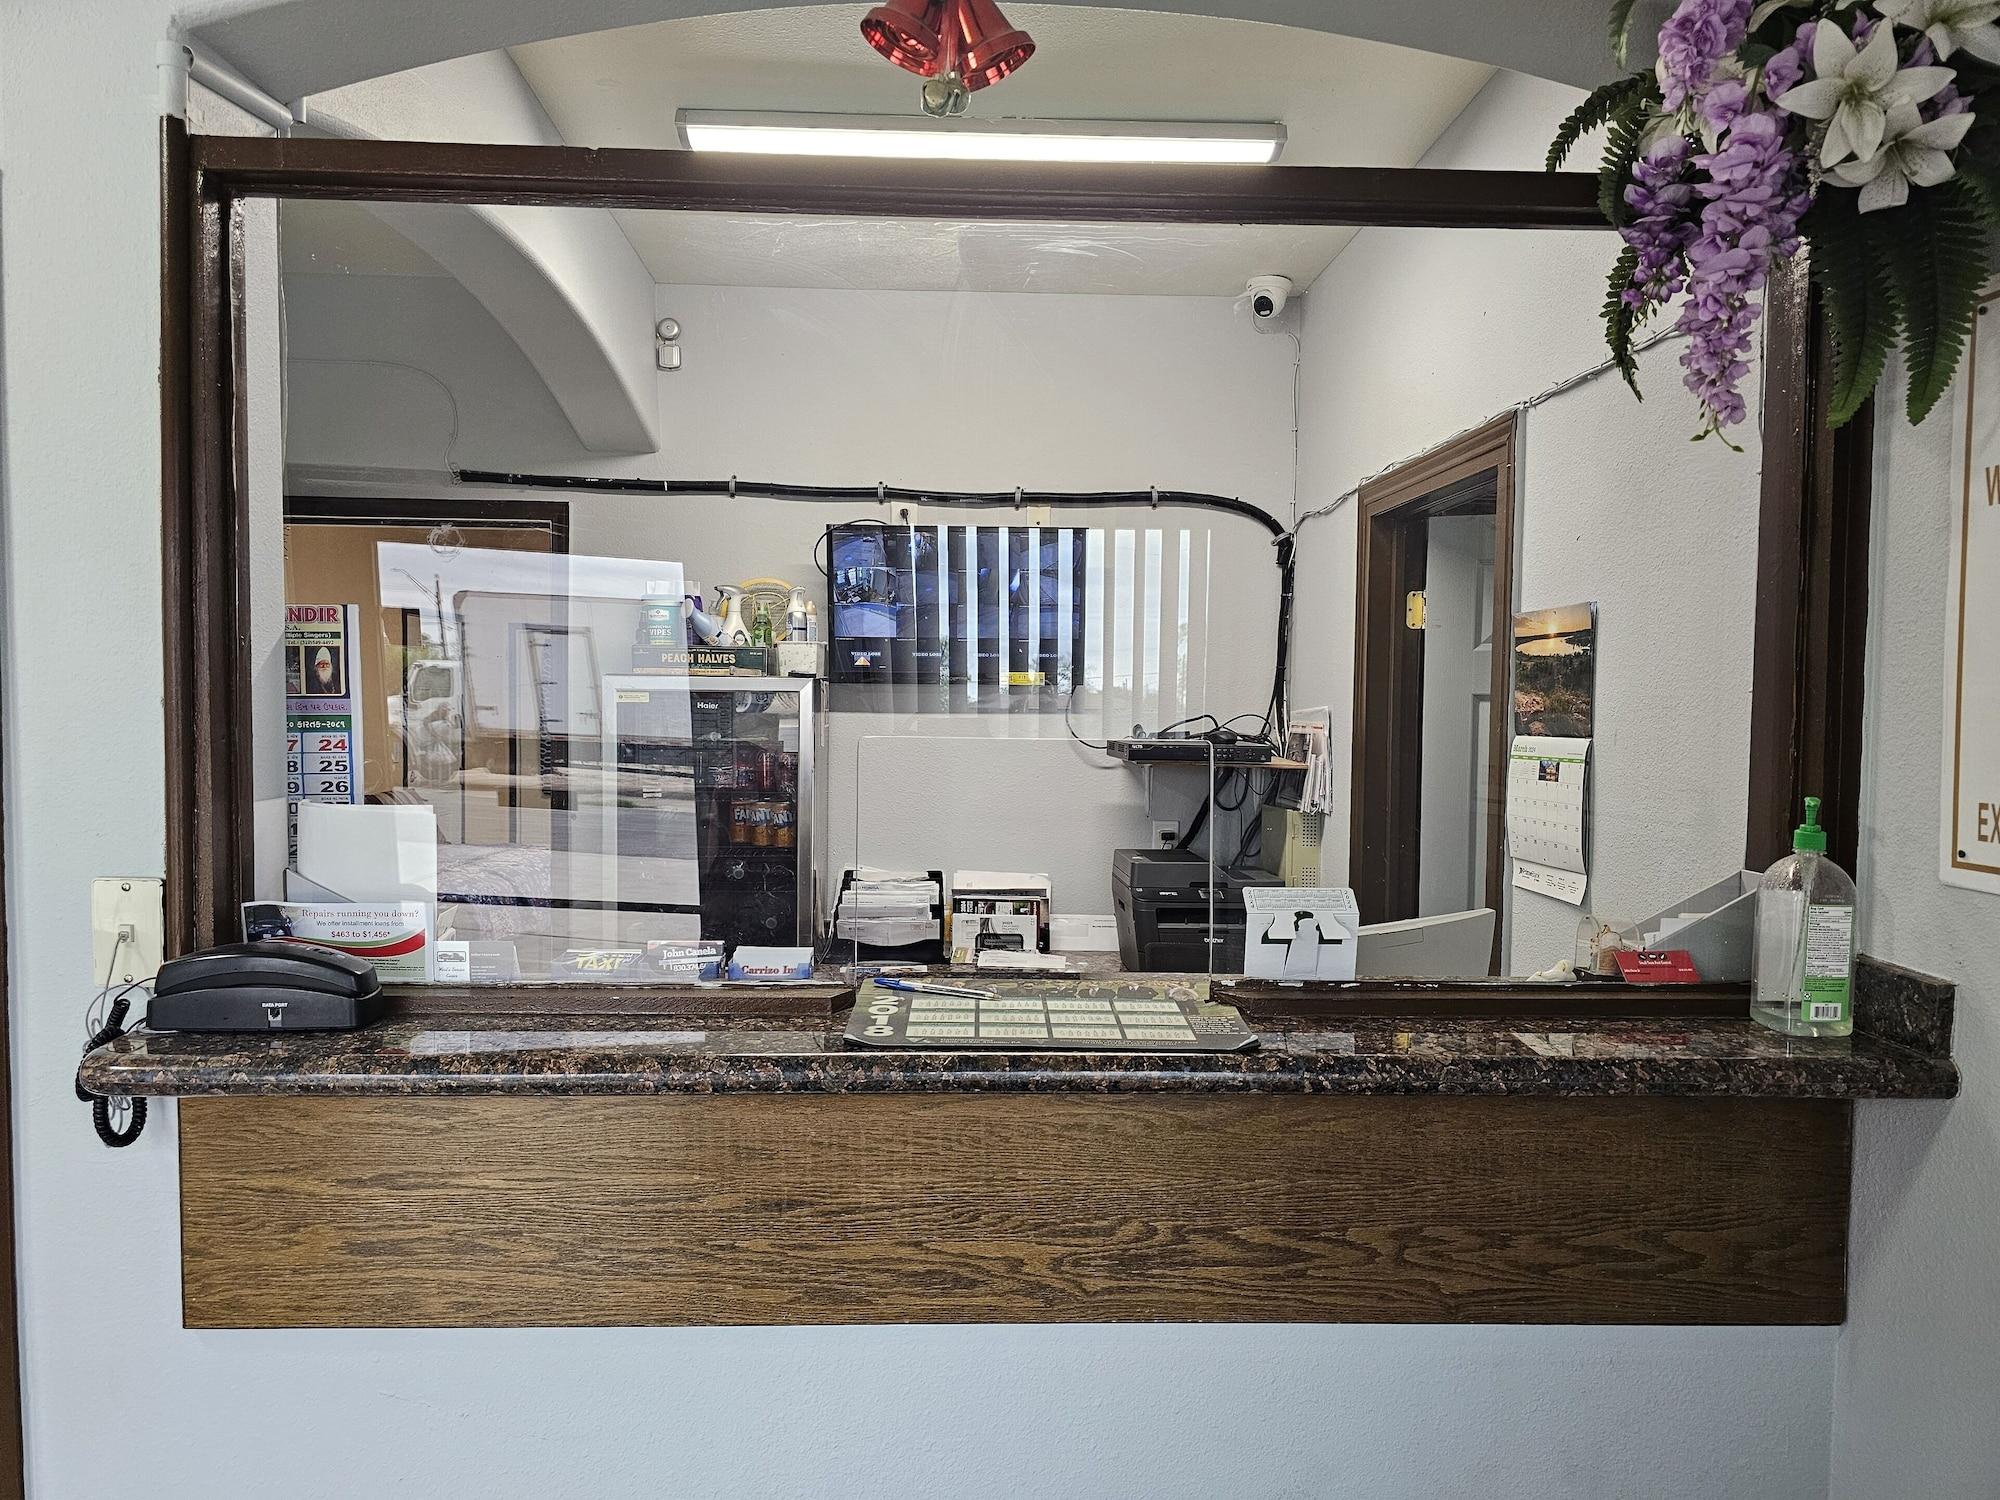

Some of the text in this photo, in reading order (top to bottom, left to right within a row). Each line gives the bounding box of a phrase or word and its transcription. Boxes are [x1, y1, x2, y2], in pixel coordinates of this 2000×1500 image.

[286, 607, 338, 623] NDIR
[661, 653, 736, 664] PEACH HALVES
[696, 701, 719, 709] Haier
[318, 738, 348, 752] 24
[319, 760, 348, 772] 25
[320, 780, 349, 793] 26
[302, 909, 419, 919] Repairs running you down?
[331, 930, 349, 938] $463
[662, 946, 716, 959] John Canela
[576, 956, 624, 970] TAXI
[741, 965, 779, 975] Carrizo
[863, 995, 900, 1037] 2018
